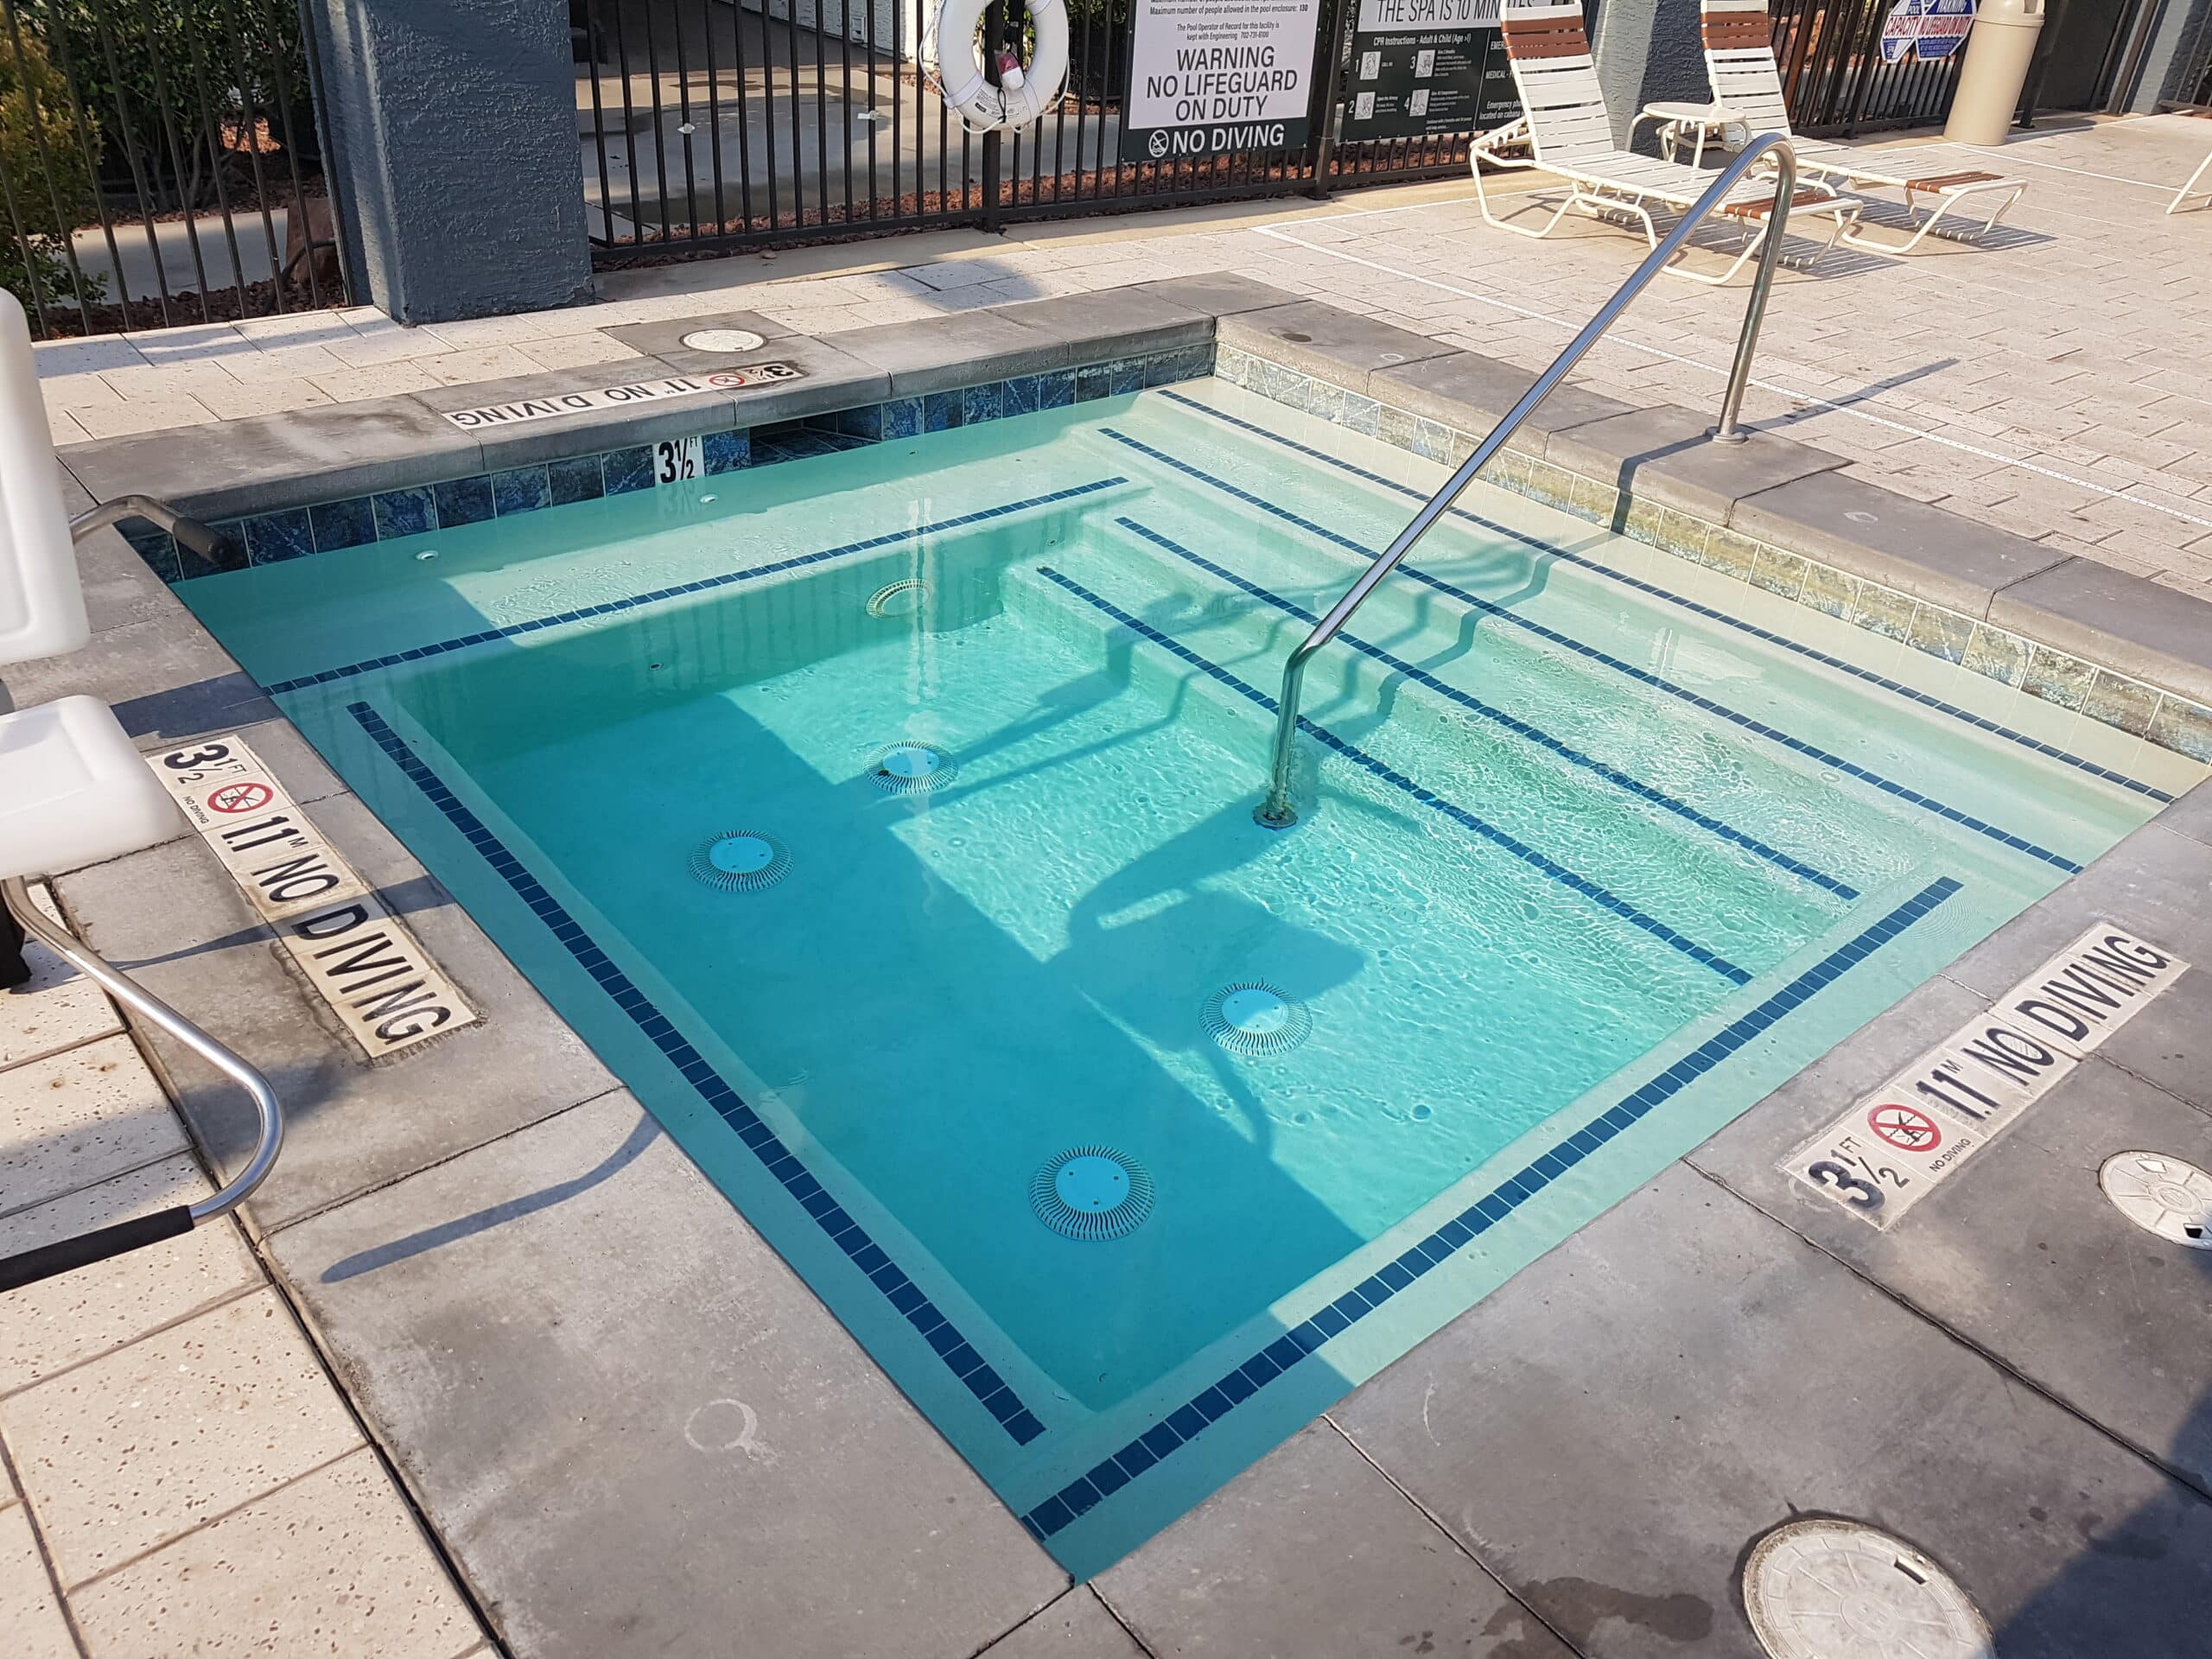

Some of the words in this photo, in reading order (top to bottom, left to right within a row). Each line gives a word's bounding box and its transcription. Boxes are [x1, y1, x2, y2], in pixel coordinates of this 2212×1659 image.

[1198, 5, 1205, 14] of
[1205, 5, 1223, 16] people
[1223, 5, 1244, 14] allowed
[1245, 4, 1249, 13] in
[1250, 4, 1259, 13] the
[1260, 4, 1271, 14] pool
[1377, 0, 1405, 22] THE
[1408, 0, 1435, 22] SPA
[1439, 0, 1452, 21] IS
[1198, 22, 1219, 32] Operator
[1210, 32, 1238, 41] Engineering
[1885, 16, 1921, 36] CAPACITY
[1374, 37, 1384, 46] CPR
[1385, 35, 1415, 46] Instructions
[1177, 46, 1275, 71] WARNING
[1354, 59, 1359, 73] 1
[1409, 56, 1416, 69] 3
[1147, 75, 1178, 99] NO
[1185, 70, 1298, 96] LIFEGUARD
[1176, 99, 1206, 121] ON
[1212, 95, 1268, 119] DUTY
[1348, 100, 1355, 113] 2
[1404, 97, 1410, 110] 4
[1487, 101, 1512, 111] Emergency
[1173, 130, 1205, 155] NO
[1211, 124, 1285, 151] DIVING
[604, 385, 657, 401] NO
[450, 394, 594, 426] DIVING
[190, 802, 210, 824] DIVING
[250, 854, 340, 903] NO
[289, 903, 452, 1046] DIVING
[1961, 1027, 2056, 1086] NO
[2014, 934, 2171, 1043] DIVING
[1929, 1159, 1946, 1173] NO
[1942, 1138, 1972, 1162] DIVING
